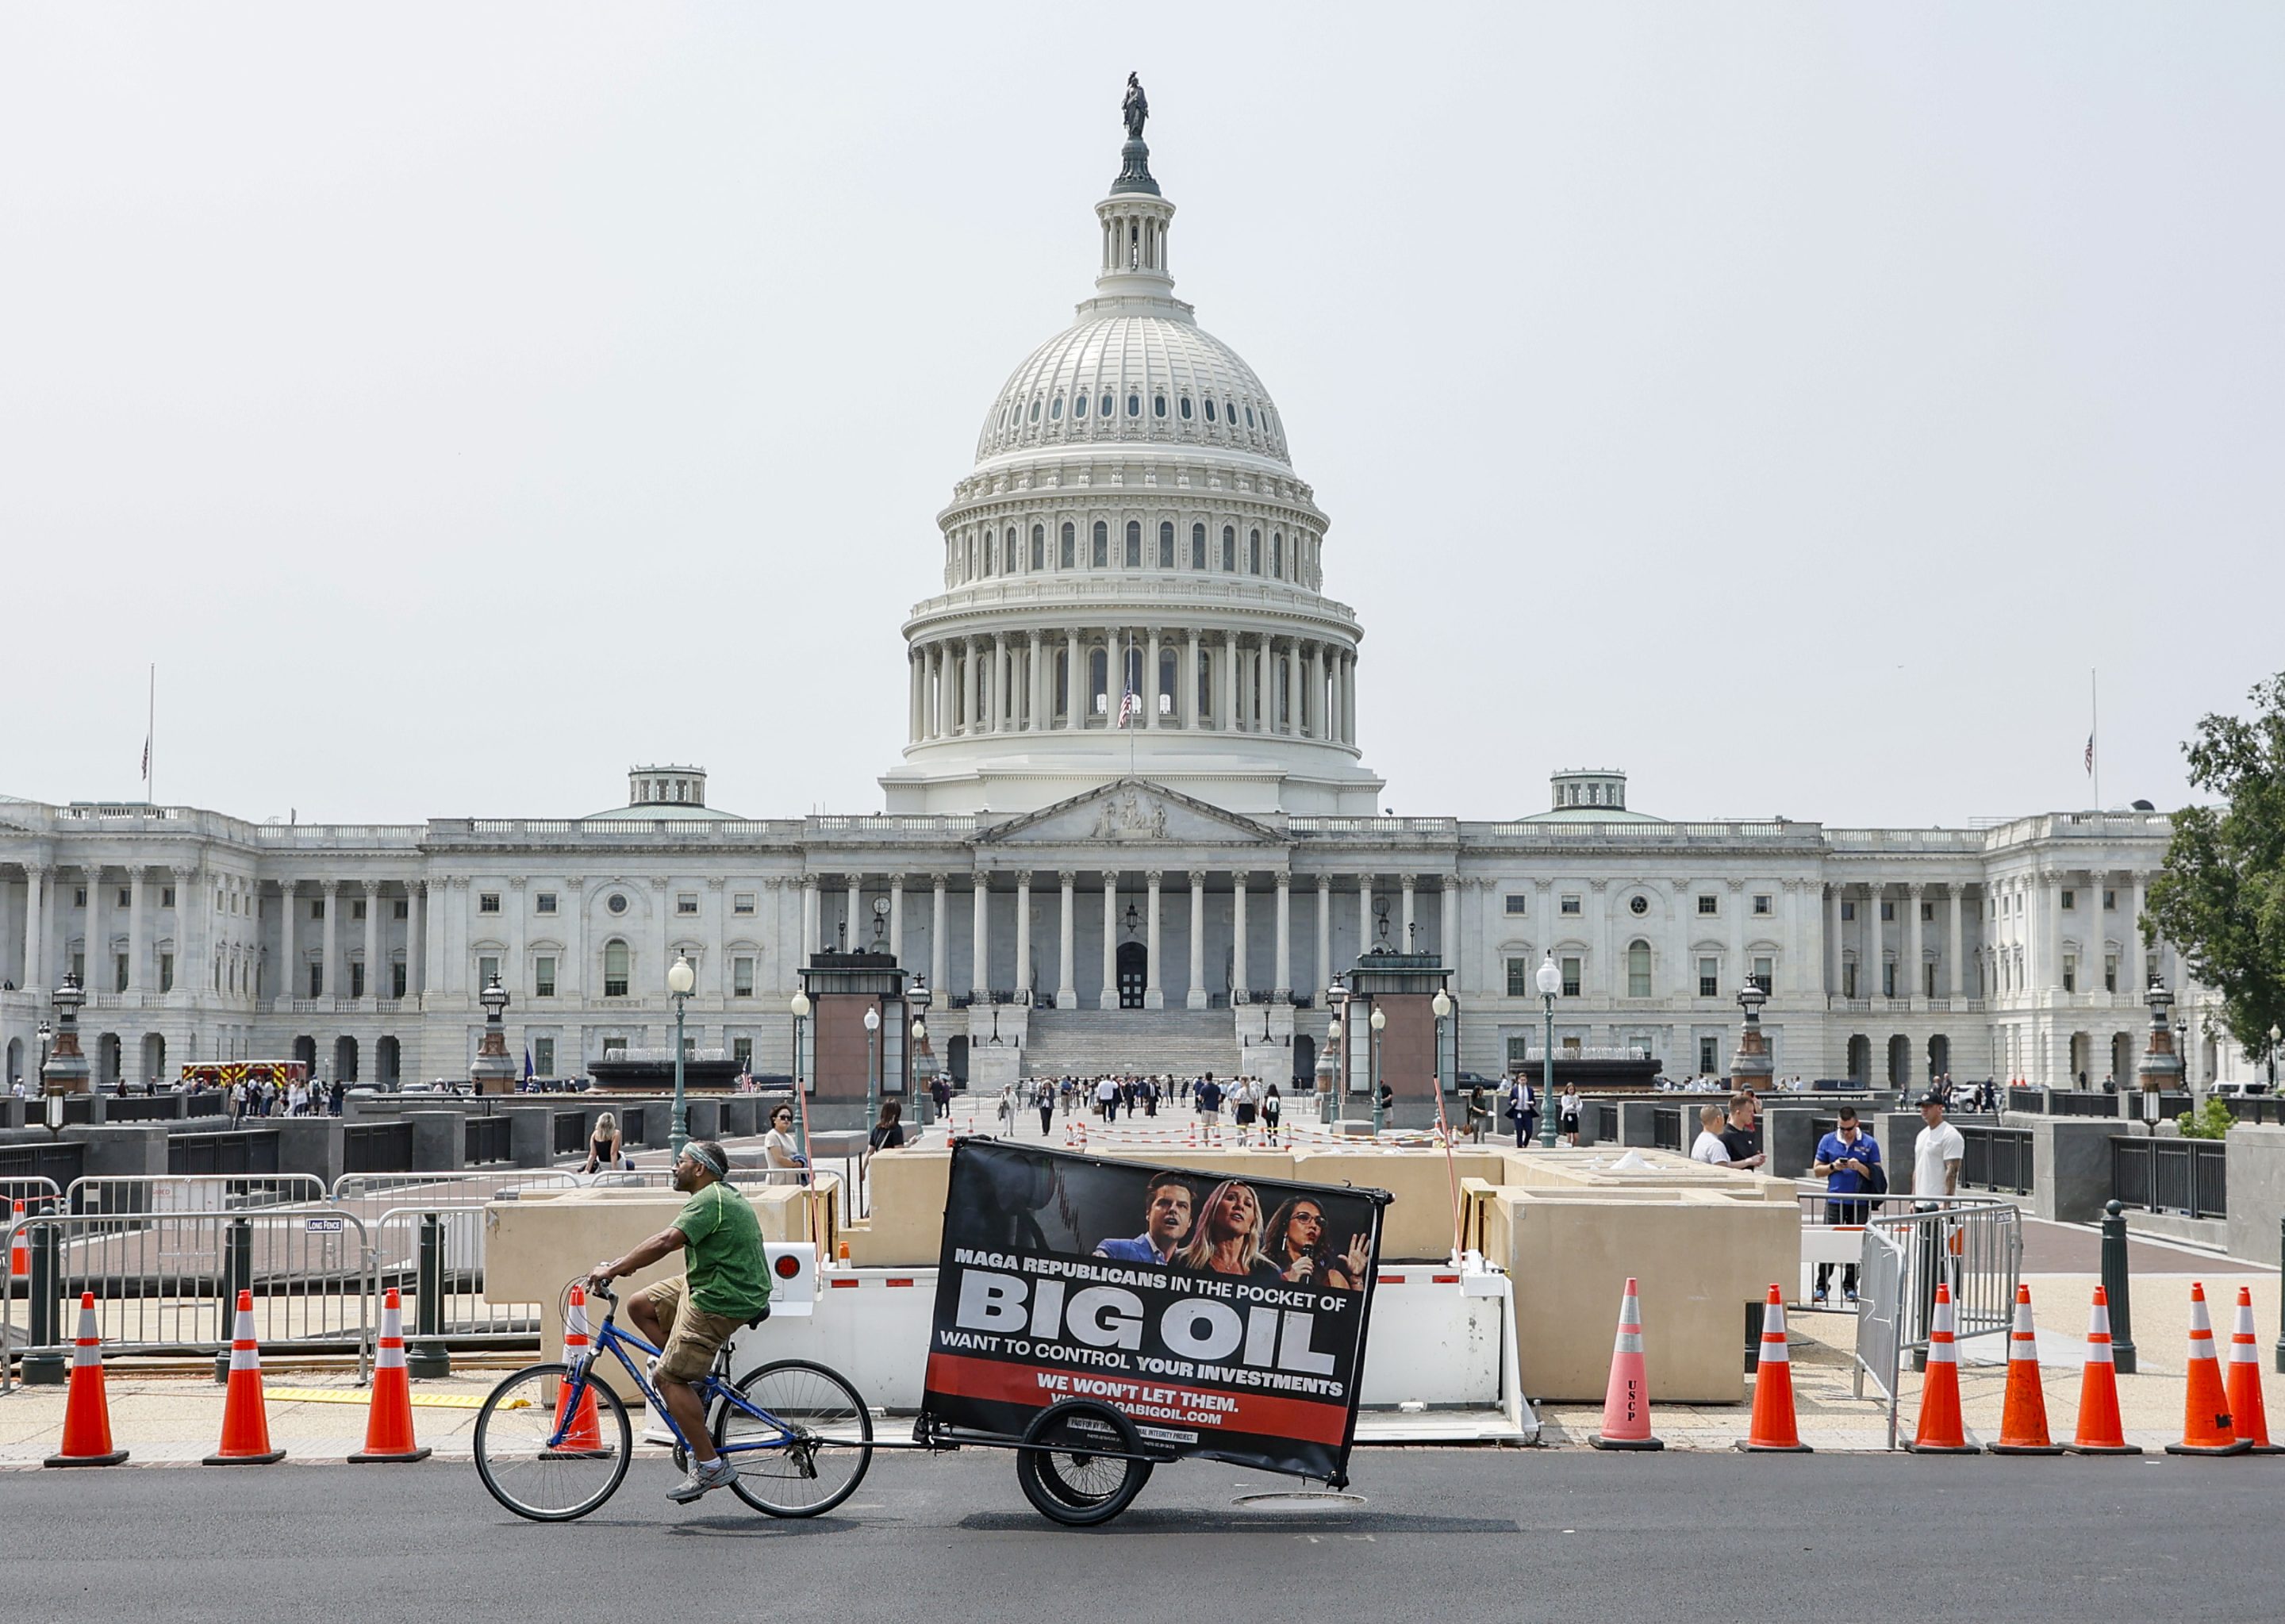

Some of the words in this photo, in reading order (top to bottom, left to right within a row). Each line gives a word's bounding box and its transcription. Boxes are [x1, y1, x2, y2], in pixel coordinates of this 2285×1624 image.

[954, 1248, 1019, 1270] MAGA
[1023, 1257, 1167, 1289] REPUBLICANS
[1170, 1276, 1191, 1293] IN
[1196, 1279, 1233, 1298] THE
[1235, 1284, 1316, 1308] POCKET
[1319, 1296, 1347, 1312] OF
[955, 1269, 1144, 1351] BIG
[1160, 1298, 1336, 1376] OIL
[939, 1330, 1000, 1351] WANT
[1004, 1338, 1031, 1356] TO
[1034, 1343, 1131, 1369] CONTROL
[1136, 1356, 1194, 1377] YOUR
[1196, 1365, 1343, 1397] INVESTMENTS
[1037, 1373, 1069, 1391] WE
[1073, 1377, 1139, 1400] WON'T
[1142, 1388, 1177, 1404] LET
[1180, 1392, 1239, 1413] THEM.
[1105, 1400, 1222, 1425] GABIGOIL.COM
[1628, 1380, 1637, 1421] USCP
[1148, 1429, 1172, 1438] INTEGRITY
